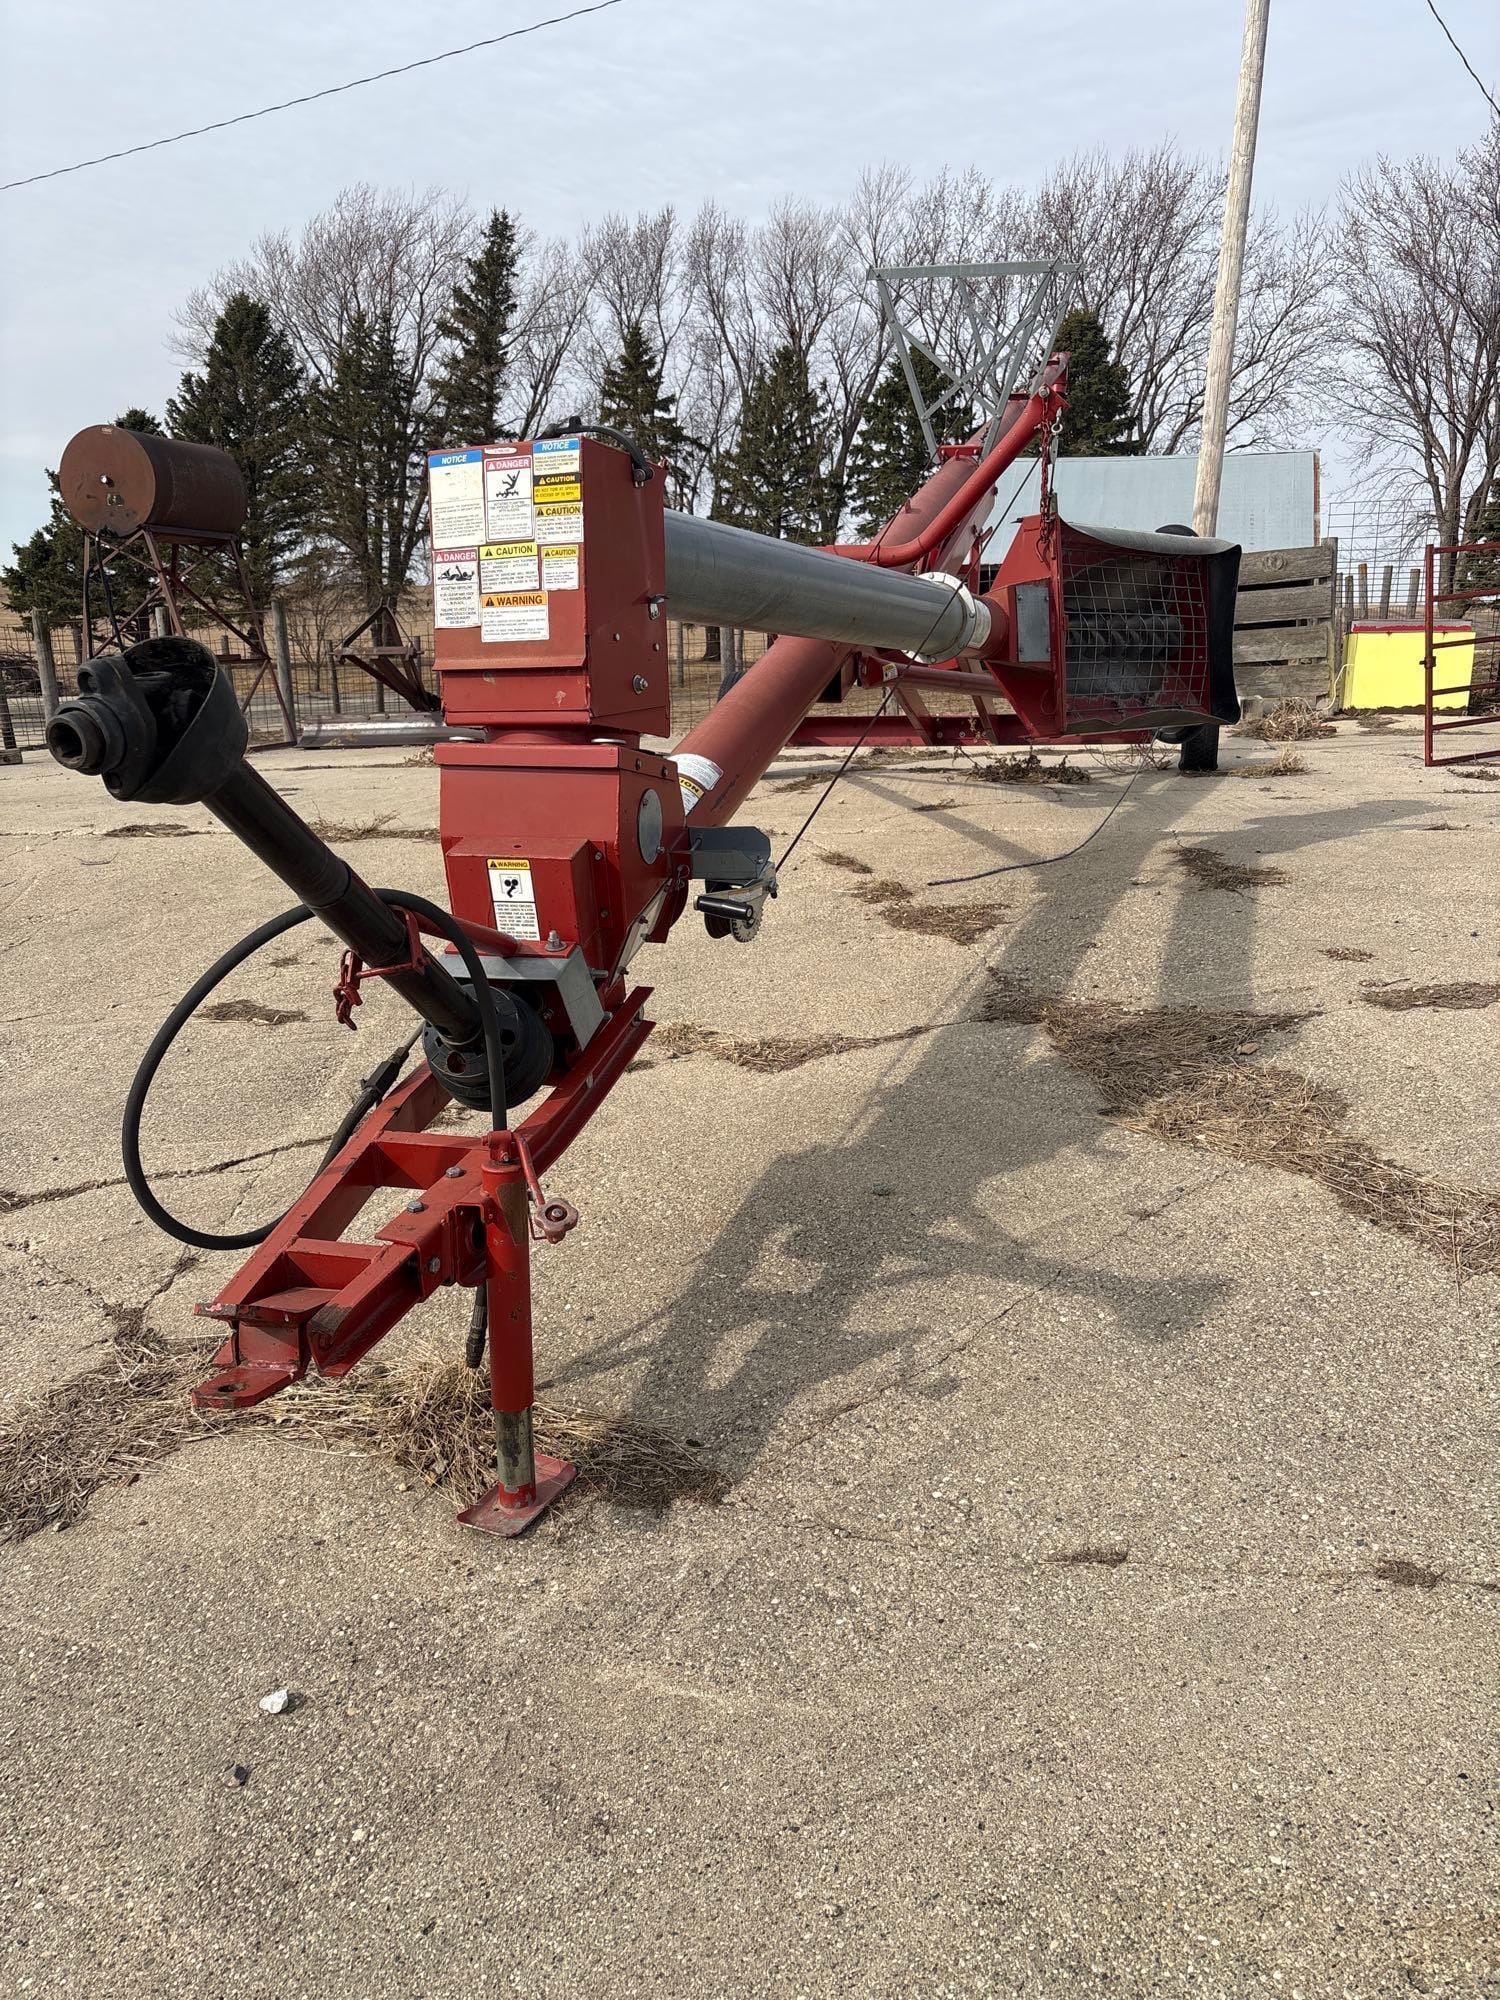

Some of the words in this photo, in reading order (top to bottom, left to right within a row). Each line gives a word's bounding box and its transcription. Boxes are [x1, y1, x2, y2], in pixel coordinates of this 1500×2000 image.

[542, 441, 569, 451] NOTICE
[441, 454, 467, 465] NOTICE
[496, 459, 529, 469] DANGER
[546, 475, 575, 483] CAUTION
[546, 506, 580, 516] CAUTION
[496, 545, 532, 556] CAUTION
[444, 552, 476, 562] DANGER
[497, 595, 542, 606] WARNING
